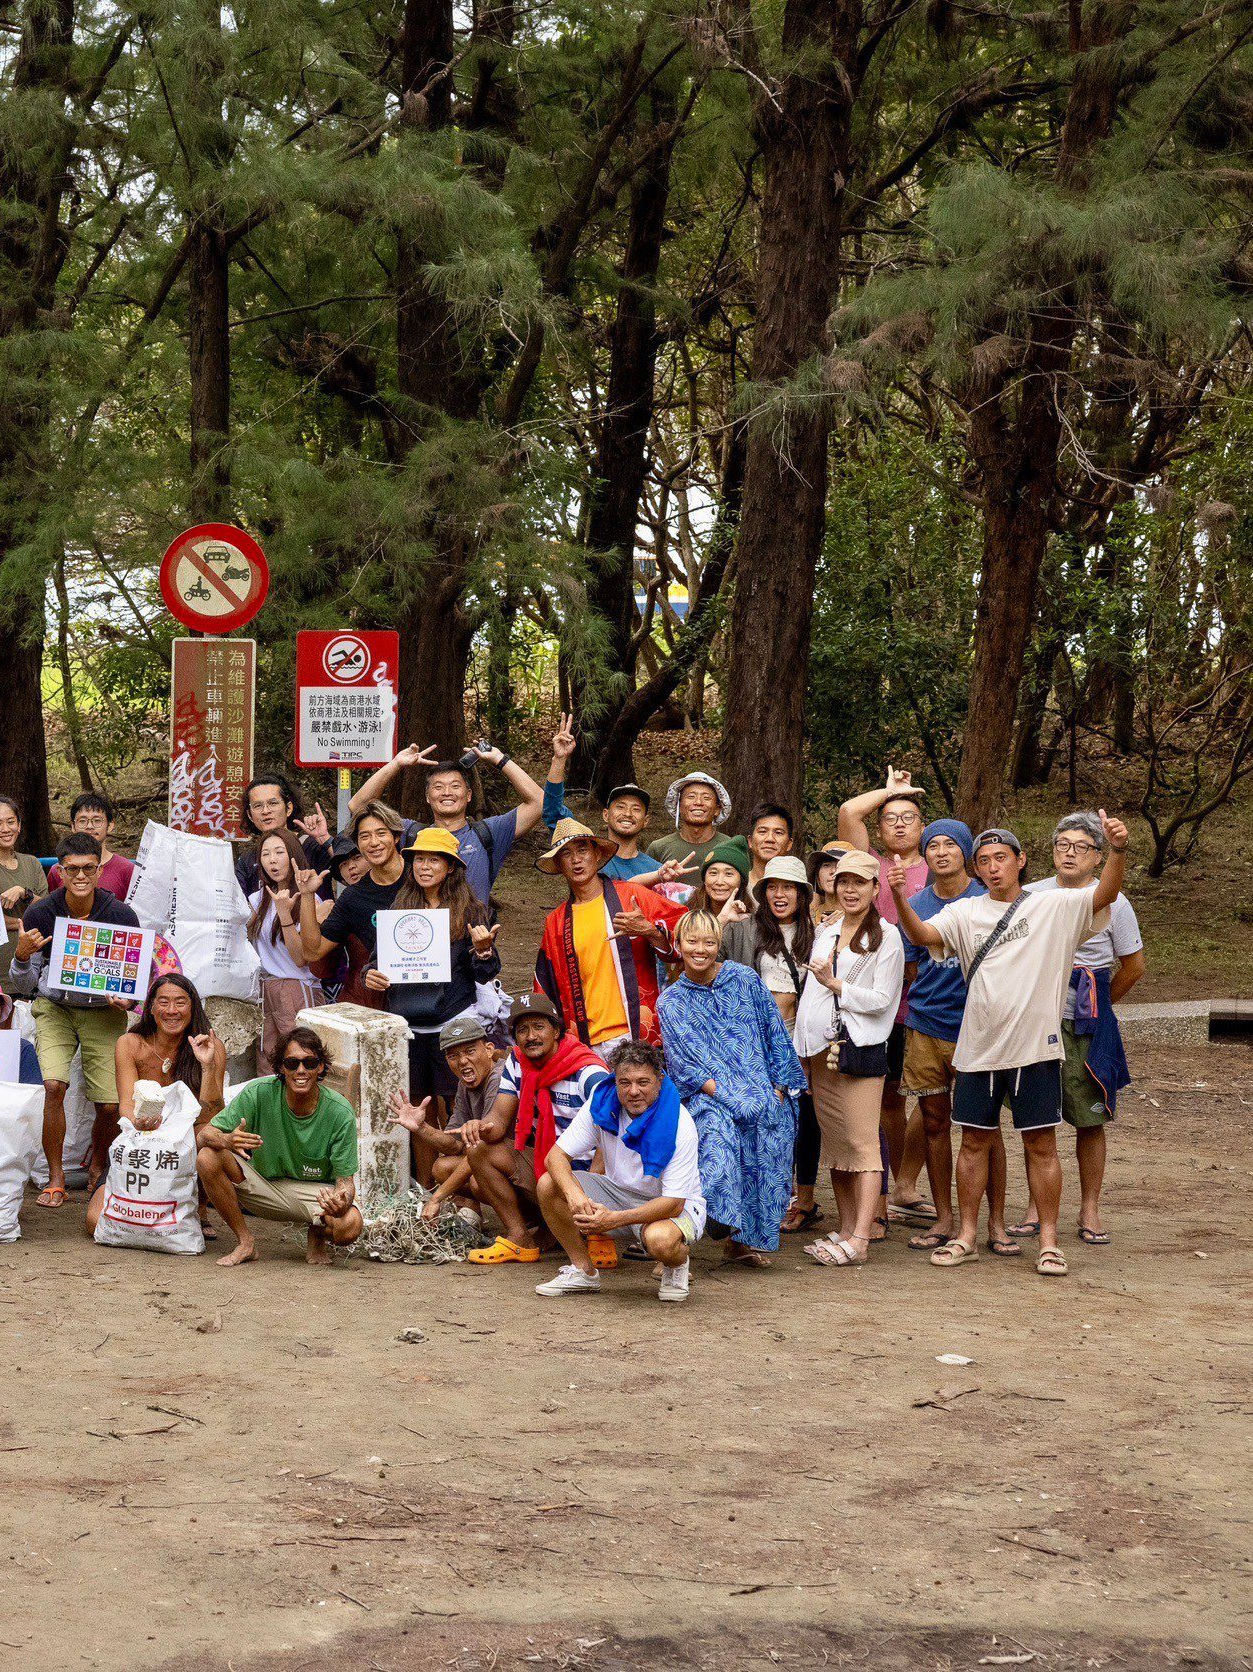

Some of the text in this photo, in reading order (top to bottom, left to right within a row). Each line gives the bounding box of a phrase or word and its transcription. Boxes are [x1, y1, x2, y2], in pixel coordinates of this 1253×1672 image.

[205, 650, 224, 763] 禁止車輛進入
[317, 737, 328, 746] No
[330, 737, 370, 749] Swimming
[93, 967, 121, 976] GOALS
[568, 957, 581, 998] BASEBALL
[126, 1171, 150, 1194] PP
[112, 1202, 166, 1219] Globalene
